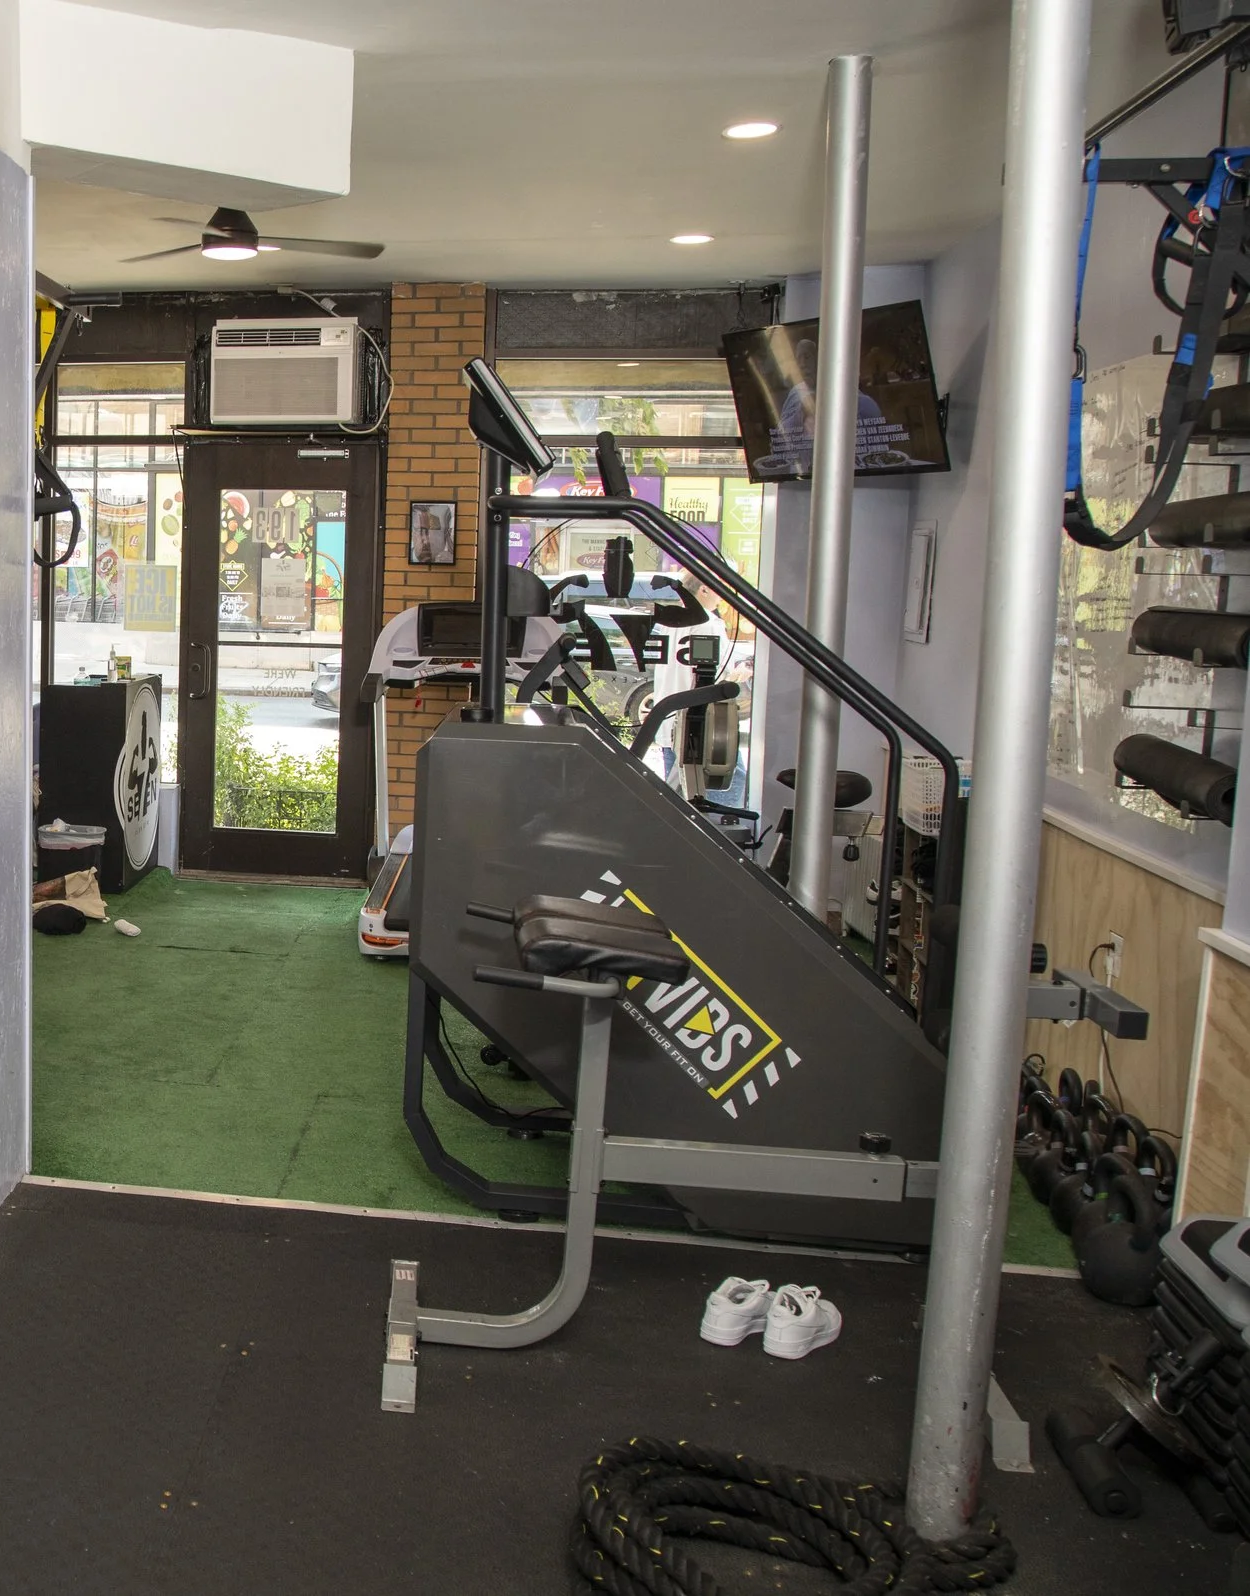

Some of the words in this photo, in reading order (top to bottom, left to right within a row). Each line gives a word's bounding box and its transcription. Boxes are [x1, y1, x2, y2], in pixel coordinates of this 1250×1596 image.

[570, 486, 596, 496] Key
[670, 497, 708, 512] Healthy
[670, 510, 705, 522] FOOD
[583, 556, 597, 565] Key
[622, 1001, 645, 1021] GET
[644, 1020, 671, 1050] YOUR
[670, 1050, 689, 1068] FIT
[686, 1066, 705, 1083] ON
